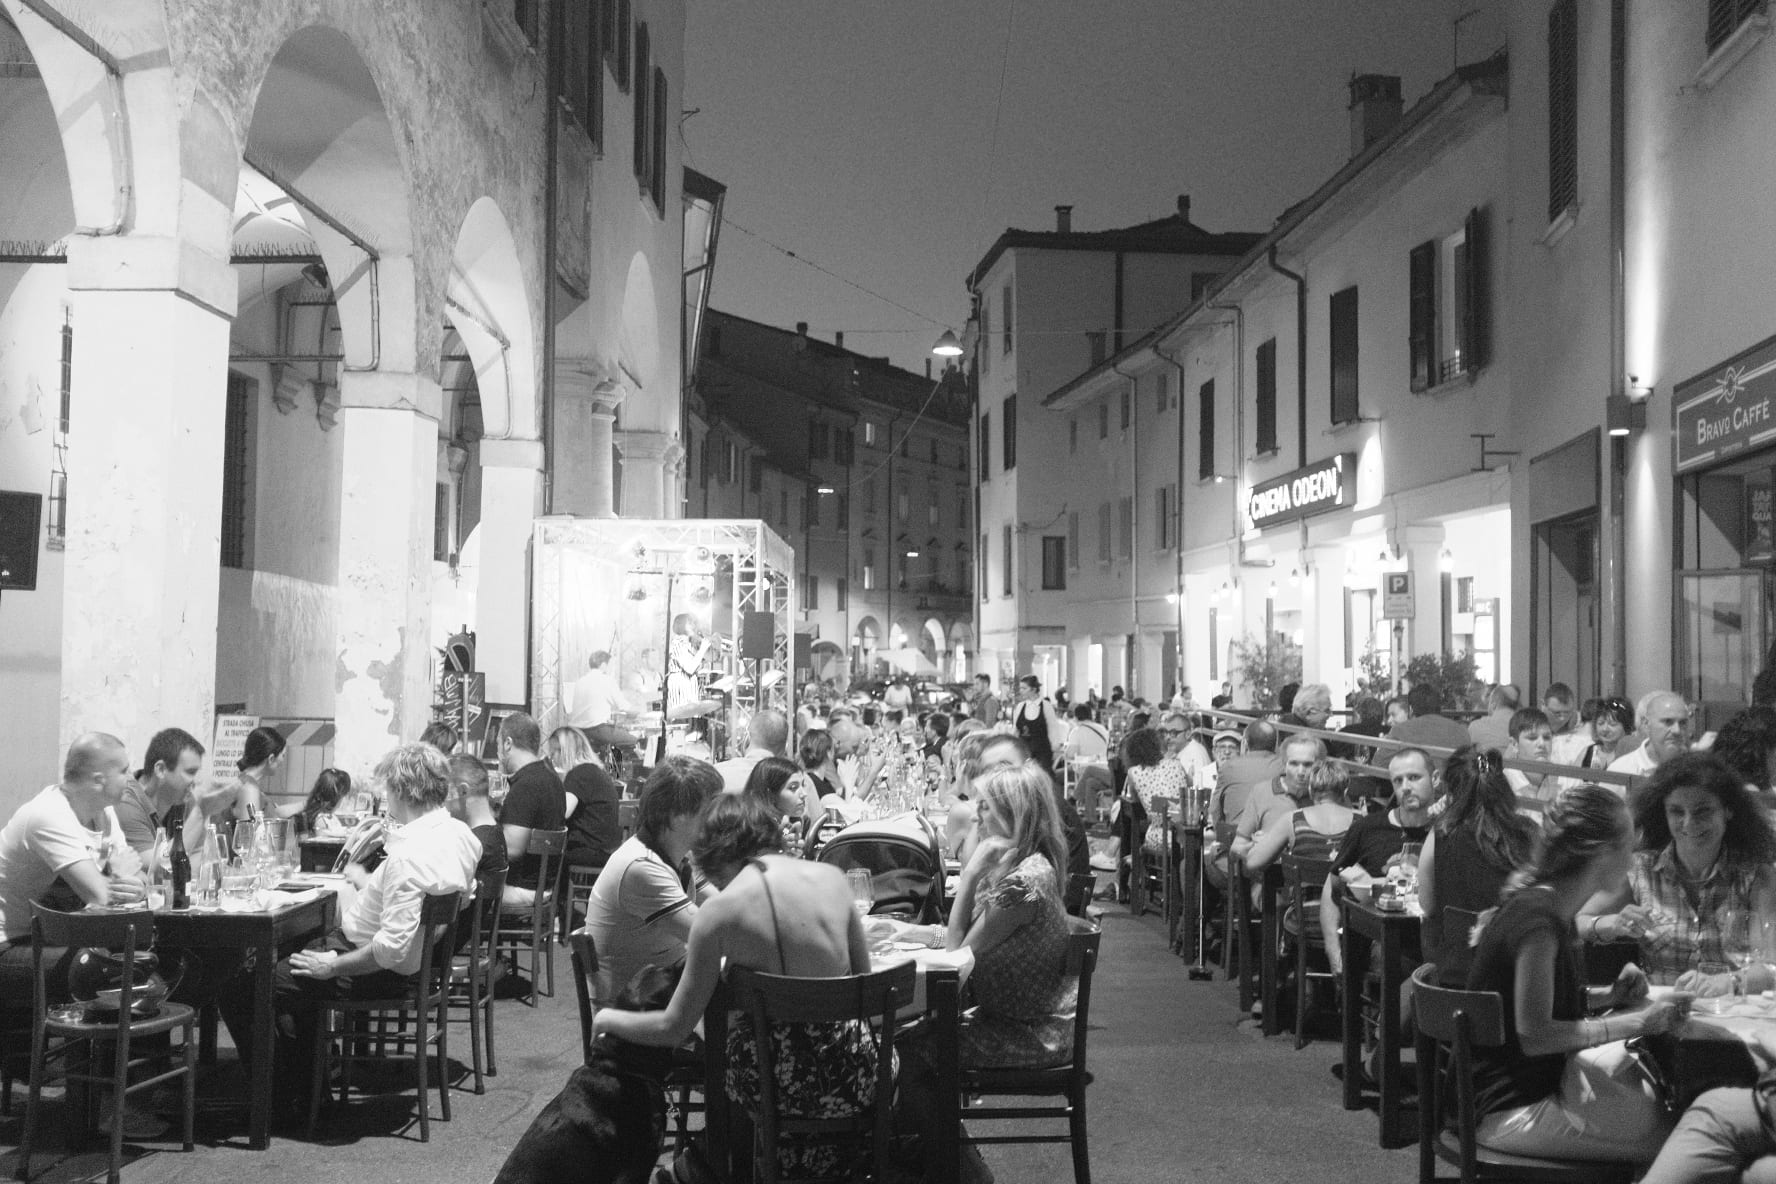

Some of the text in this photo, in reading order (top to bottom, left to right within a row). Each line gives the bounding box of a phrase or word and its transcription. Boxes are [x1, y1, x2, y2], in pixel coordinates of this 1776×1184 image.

[1697, 417, 1730, 445] BRAVO
[1251, 467, 1337, 520] CINEMA ODEON
[1393, 577, 1405, 592] P
